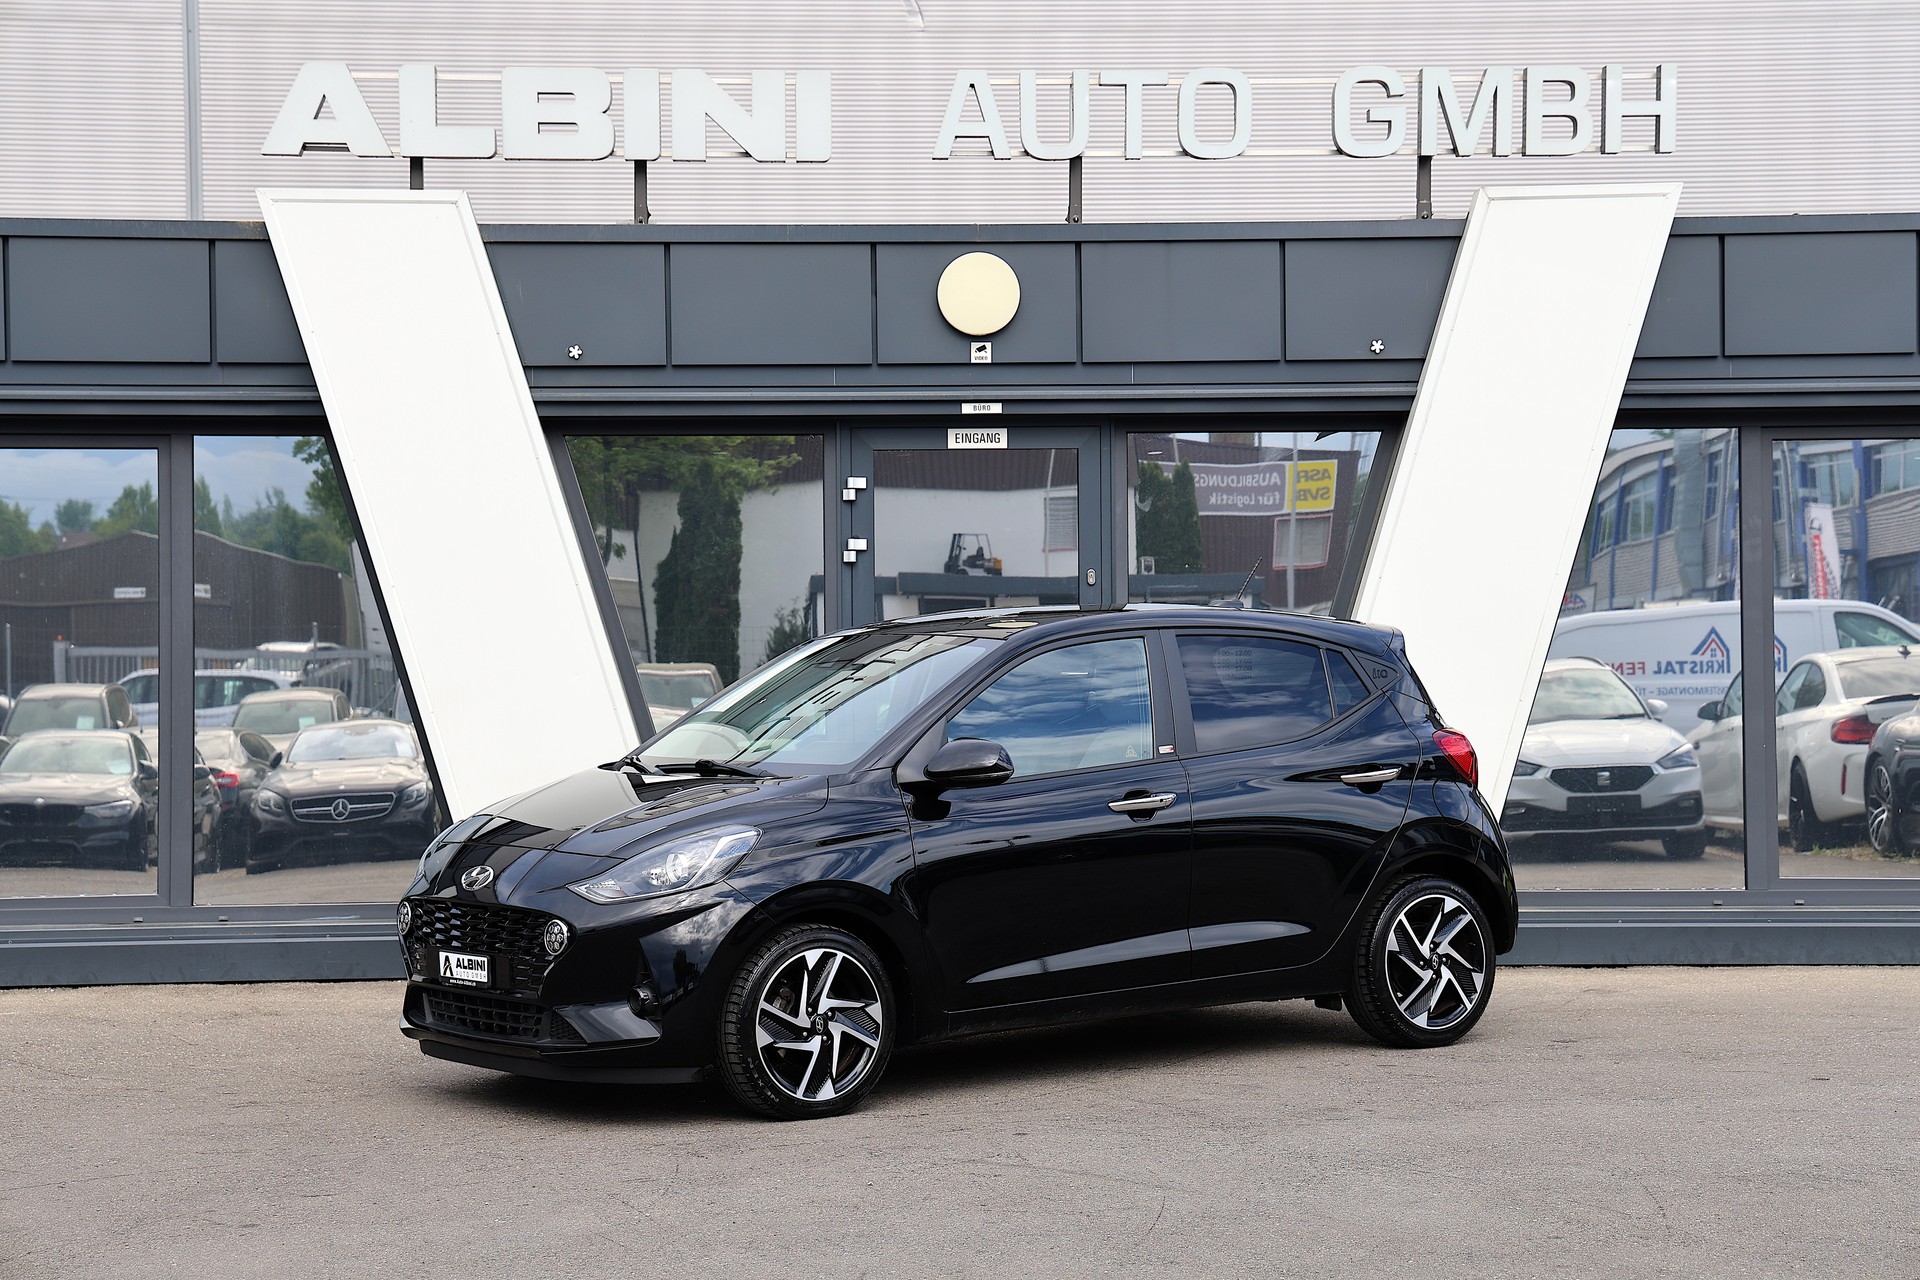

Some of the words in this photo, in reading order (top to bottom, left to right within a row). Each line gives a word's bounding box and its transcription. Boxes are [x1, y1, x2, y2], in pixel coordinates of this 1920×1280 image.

[261, 62, 832, 162] ALBINI
[932, 66, 1253, 160] AUTO
[1331, 64, 1678, 159] GMBH
[973, 404, 991, 412] BÜRO
[954, 432, 1001, 444] EINGANG
[456, 957, 486, 972] ALBINI
